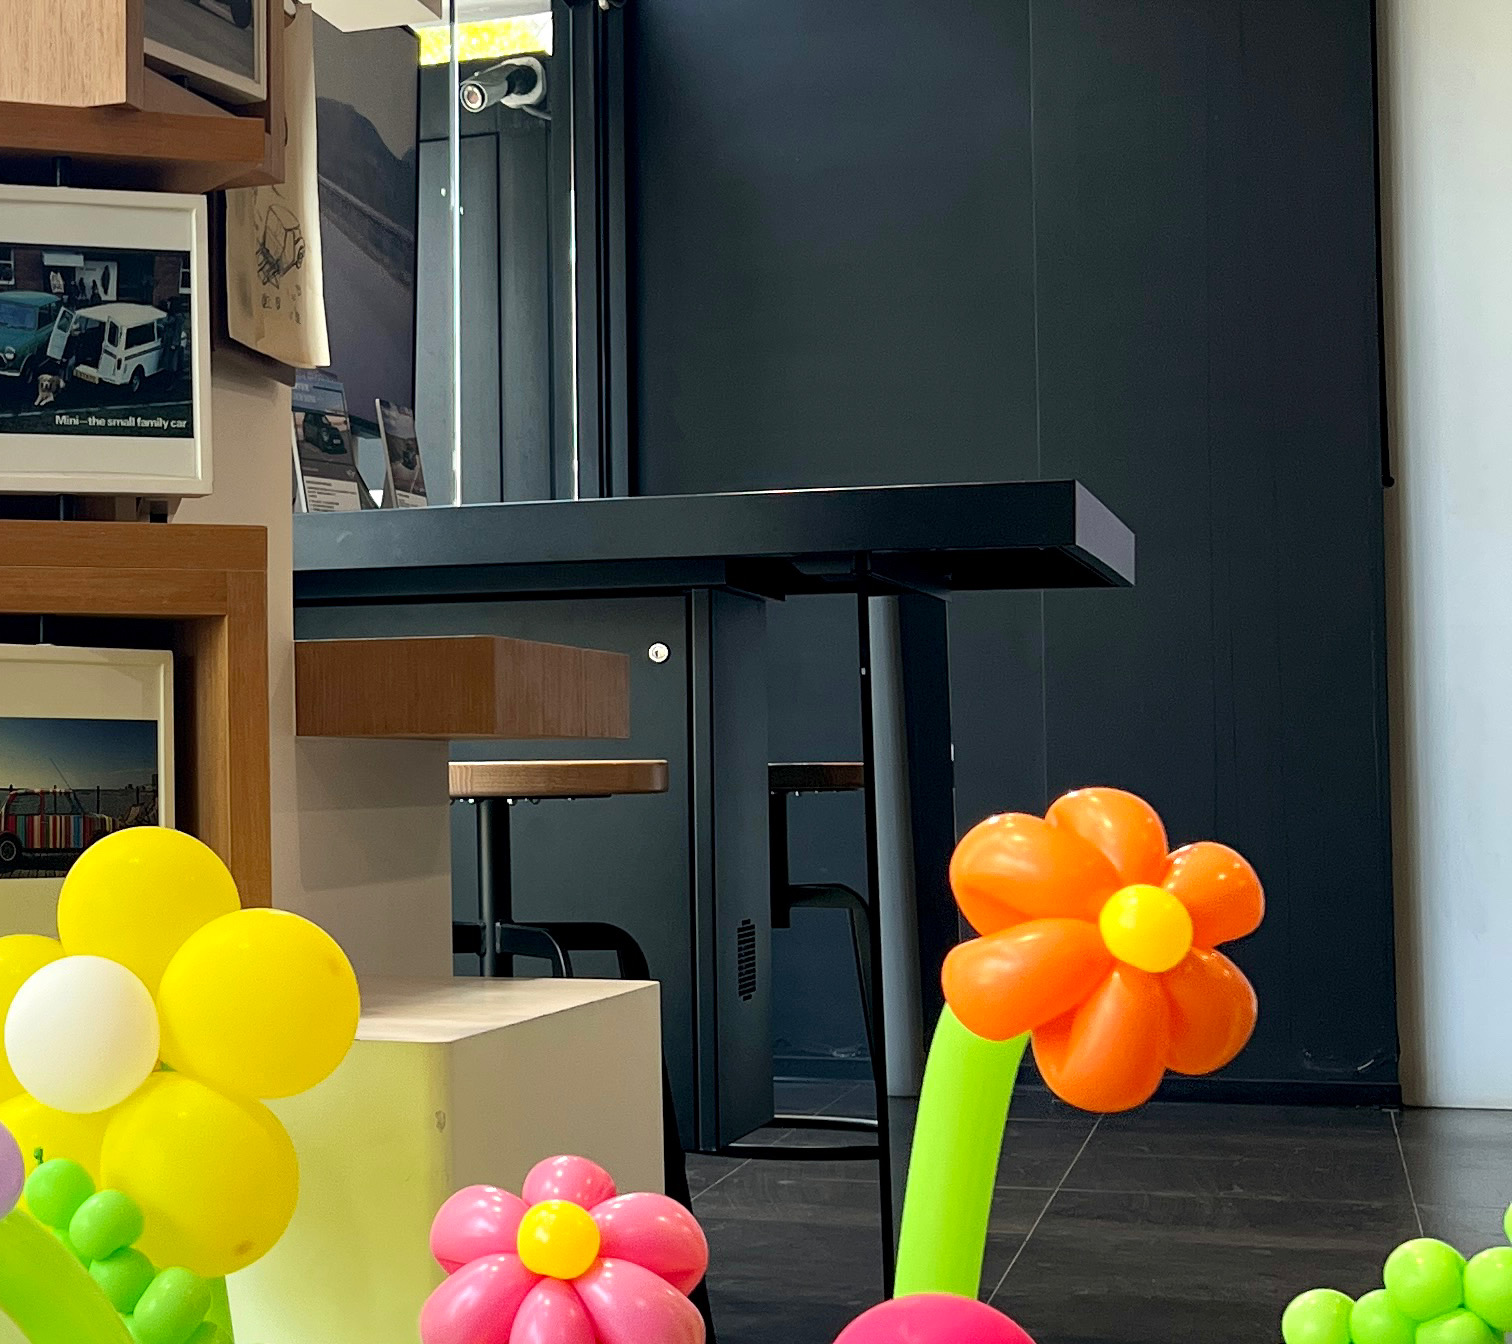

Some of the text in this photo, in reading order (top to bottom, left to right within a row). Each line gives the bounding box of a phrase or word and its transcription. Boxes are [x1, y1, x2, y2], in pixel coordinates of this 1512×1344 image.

[107, 416, 136, 427] small
[137, 416, 169, 430] family
[170, 419, 188, 428] car
